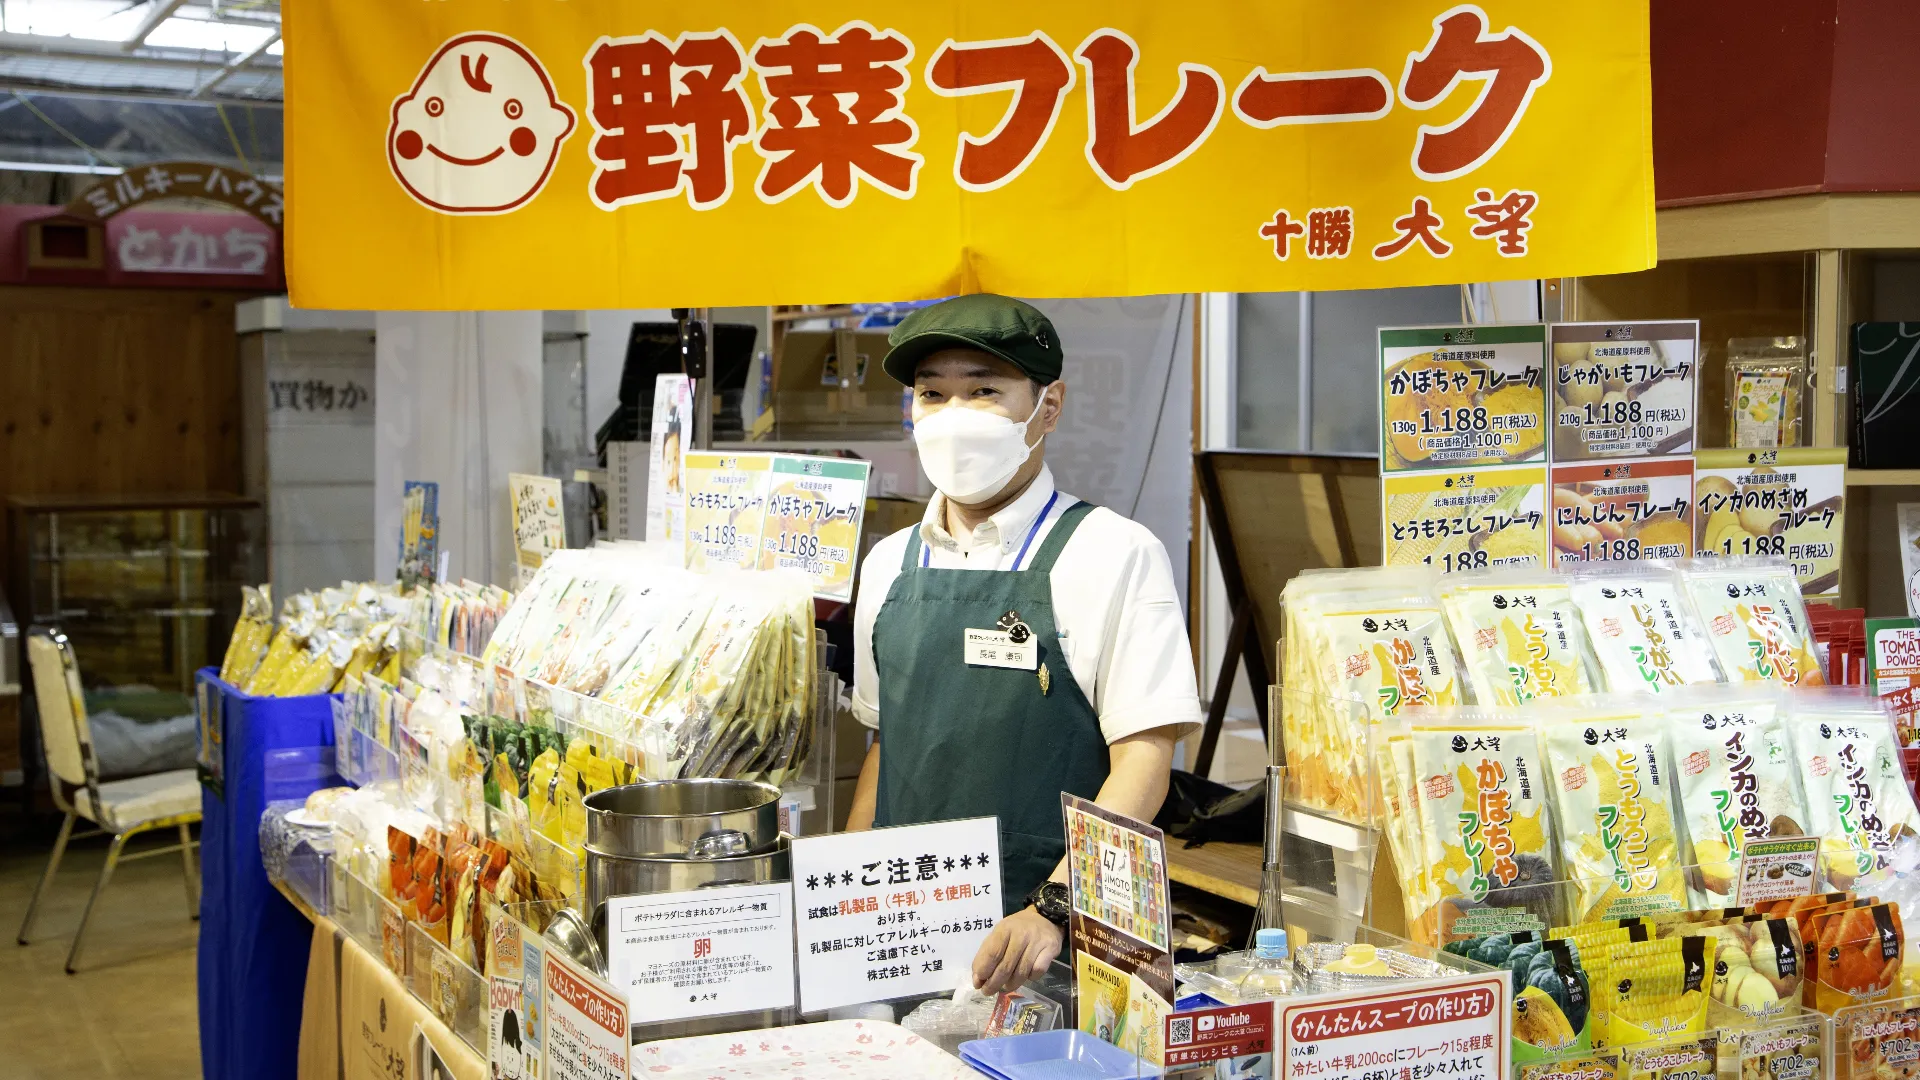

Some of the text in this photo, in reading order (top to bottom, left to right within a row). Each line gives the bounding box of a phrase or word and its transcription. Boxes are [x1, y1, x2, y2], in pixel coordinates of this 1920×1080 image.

[585, 4, 1553, 212] 野菜フレーク
[85, 165, 284, 224] ミルキーハウス
[1260, 188, 1539, 261] 十勝 大望
[118, 225, 271, 274] とかち
[1432, 350, 1495, 362] 北海道産原料使用
[1594, 346, 1650, 356] 北海道産原料使用
[1390, 365, 1541, 395] かぼちゃフレーク
[1556, 361, 1691, 386] じゃがいもフレーク
[1392, 421, 1416, 435] 130g
[1420, 407, 1488, 435] 1,188
[1560, 413, 1581, 427] 210g
[1583, 401, 1642, 426] 1,188
[1593, 484, 1649, 496] 北海道産原料使用
[1736, 473, 1797, 485] 北海道産原料使用
[689, 492, 764, 511] とうもろこしフレーク
[1433, 494, 1496, 507] 北海道産原料使用
[1557, 497, 1688, 526] にんじんフレーク
[1699, 488, 1808, 514] インカのめざめ
[1391, 511, 1541, 541] とうもろこしフレーク
[1779, 508, 1835, 531] フレーク
[1723, 535, 1785, 555] 1188
[1511, 595, 1537, 608] 大望
[1382, 618, 1410, 632] 大望
[1660, 599, 1684, 640] 北海道産
[1896, 630, 1915, 640] THE
[1470, 735, 1501, 751] 大望
[1602, 728, 1628, 743] 大望
[1515, 756, 1532, 800] 北海道産
[1475, 757, 1519, 888] かぼちゃ
[1614, 747, 1659, 891] とうもろこし
[1103, 848, 1116, 873] 47
[1458, 812, 1491, 904] フレーク
[1104, 872, 1131, 892] JIMOTO
[634, 902, 768, 922] ポテトサラダに含まれるアレルギー物質
[877, 910, 921, 926] おります。
[810, 917, 994, 954] 乳製品に対してアレルギーのある方は
[694, 938, 712, 959] 卵
[866, 943, 936, 961] ご遠慮下さい。
[866, 953, 943, 981] 株式会社 大望
[547, 963, 623, 1034] かんたんスープの作り方!
[1216, 1011, 1250, 1028] YouTube
[1295, 992, 1490, 1038] かんたんスープの作り方!
[1170, 1044, 1238, 1062] 簡単なレシピを
[1291, 1044, 1319, 1057] (1人前)
[1291, 1033, 1494, 1077] 冷たい牛乳200ccにフレーク15g程度
[1881, 1038, 1912, 1056] ¥702
[1771, 1054, 1804, 1073] ¥702
